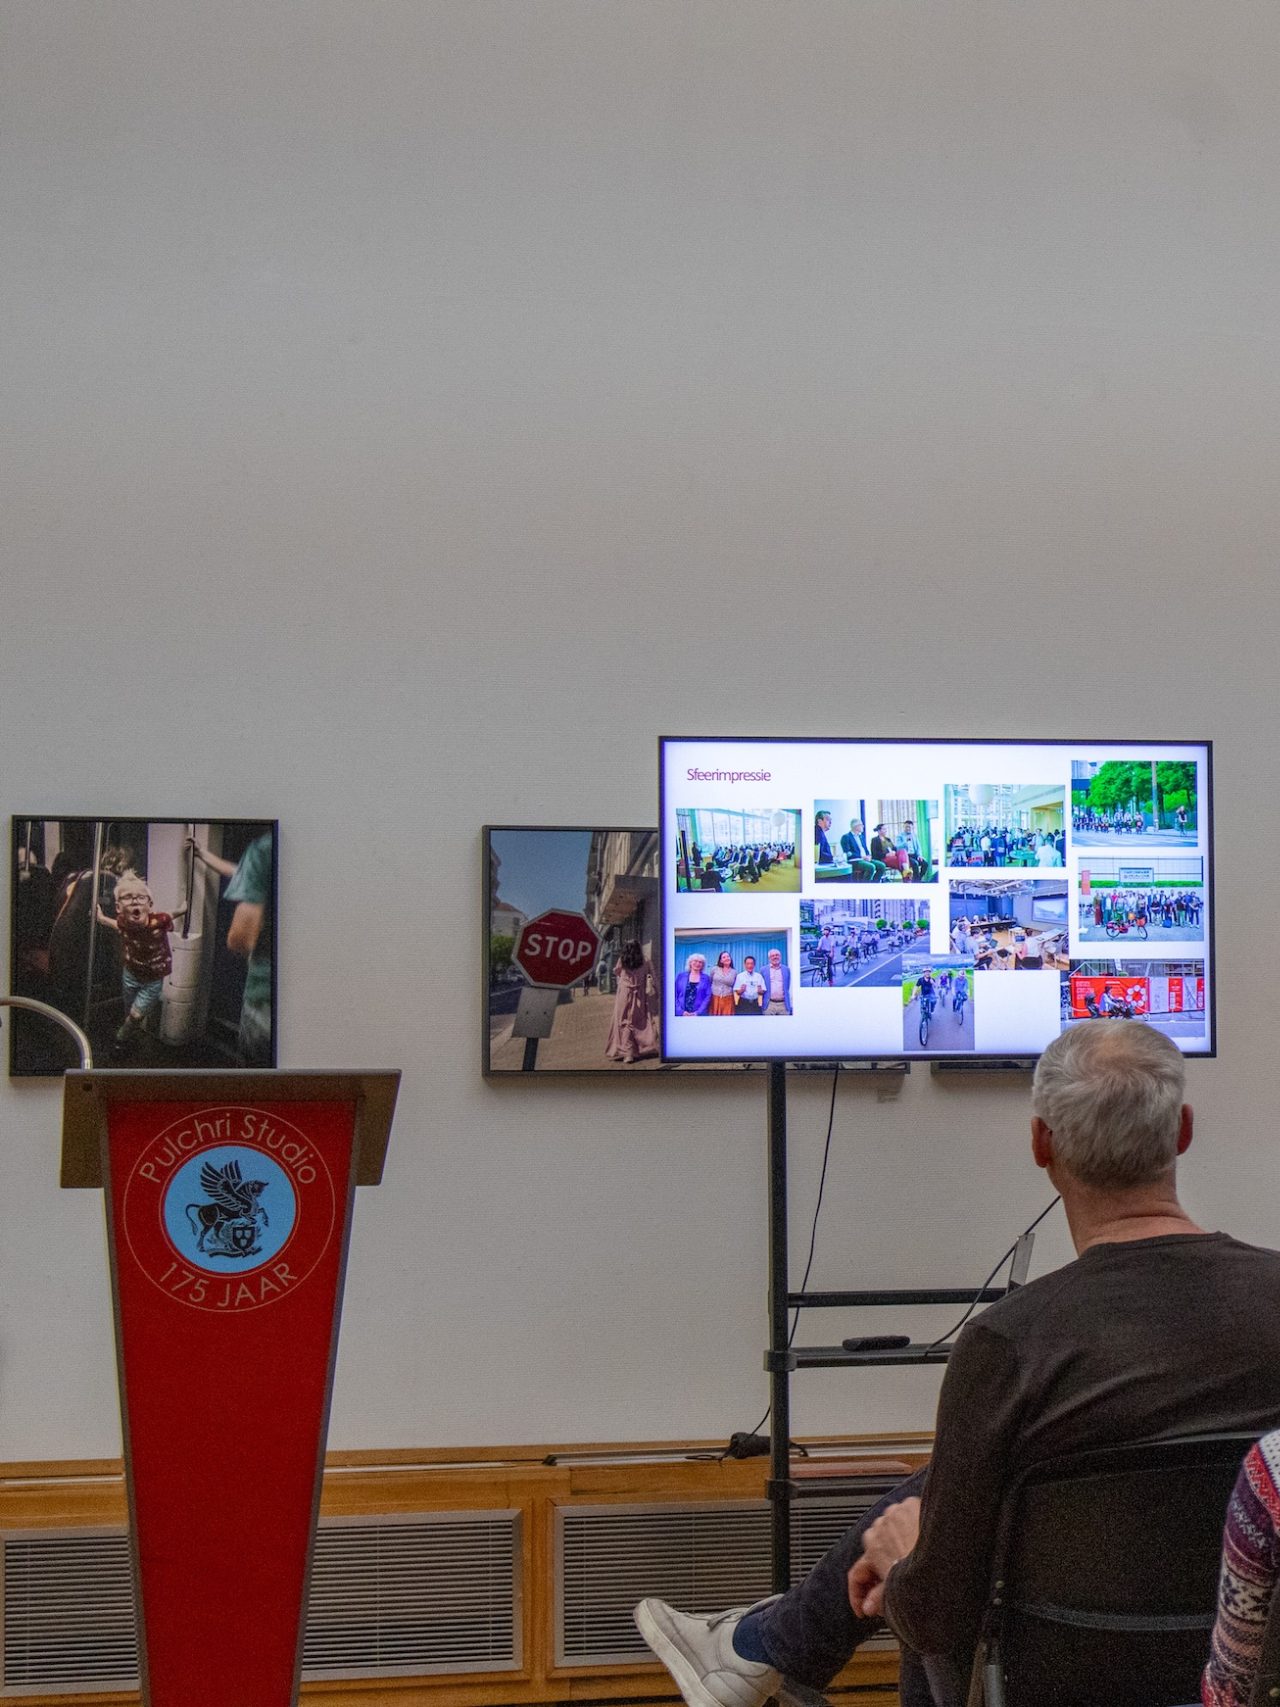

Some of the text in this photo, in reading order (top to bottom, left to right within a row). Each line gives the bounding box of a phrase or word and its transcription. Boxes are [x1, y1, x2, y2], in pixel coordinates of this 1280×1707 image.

[687, 767, 772, 784] Sfeerimpressie
[524, 933, 592, 962] STOP
[138, 1113, 317, 1184] Pulchri Studio
[159, 1262, 298, 1308] 175 JAAR
